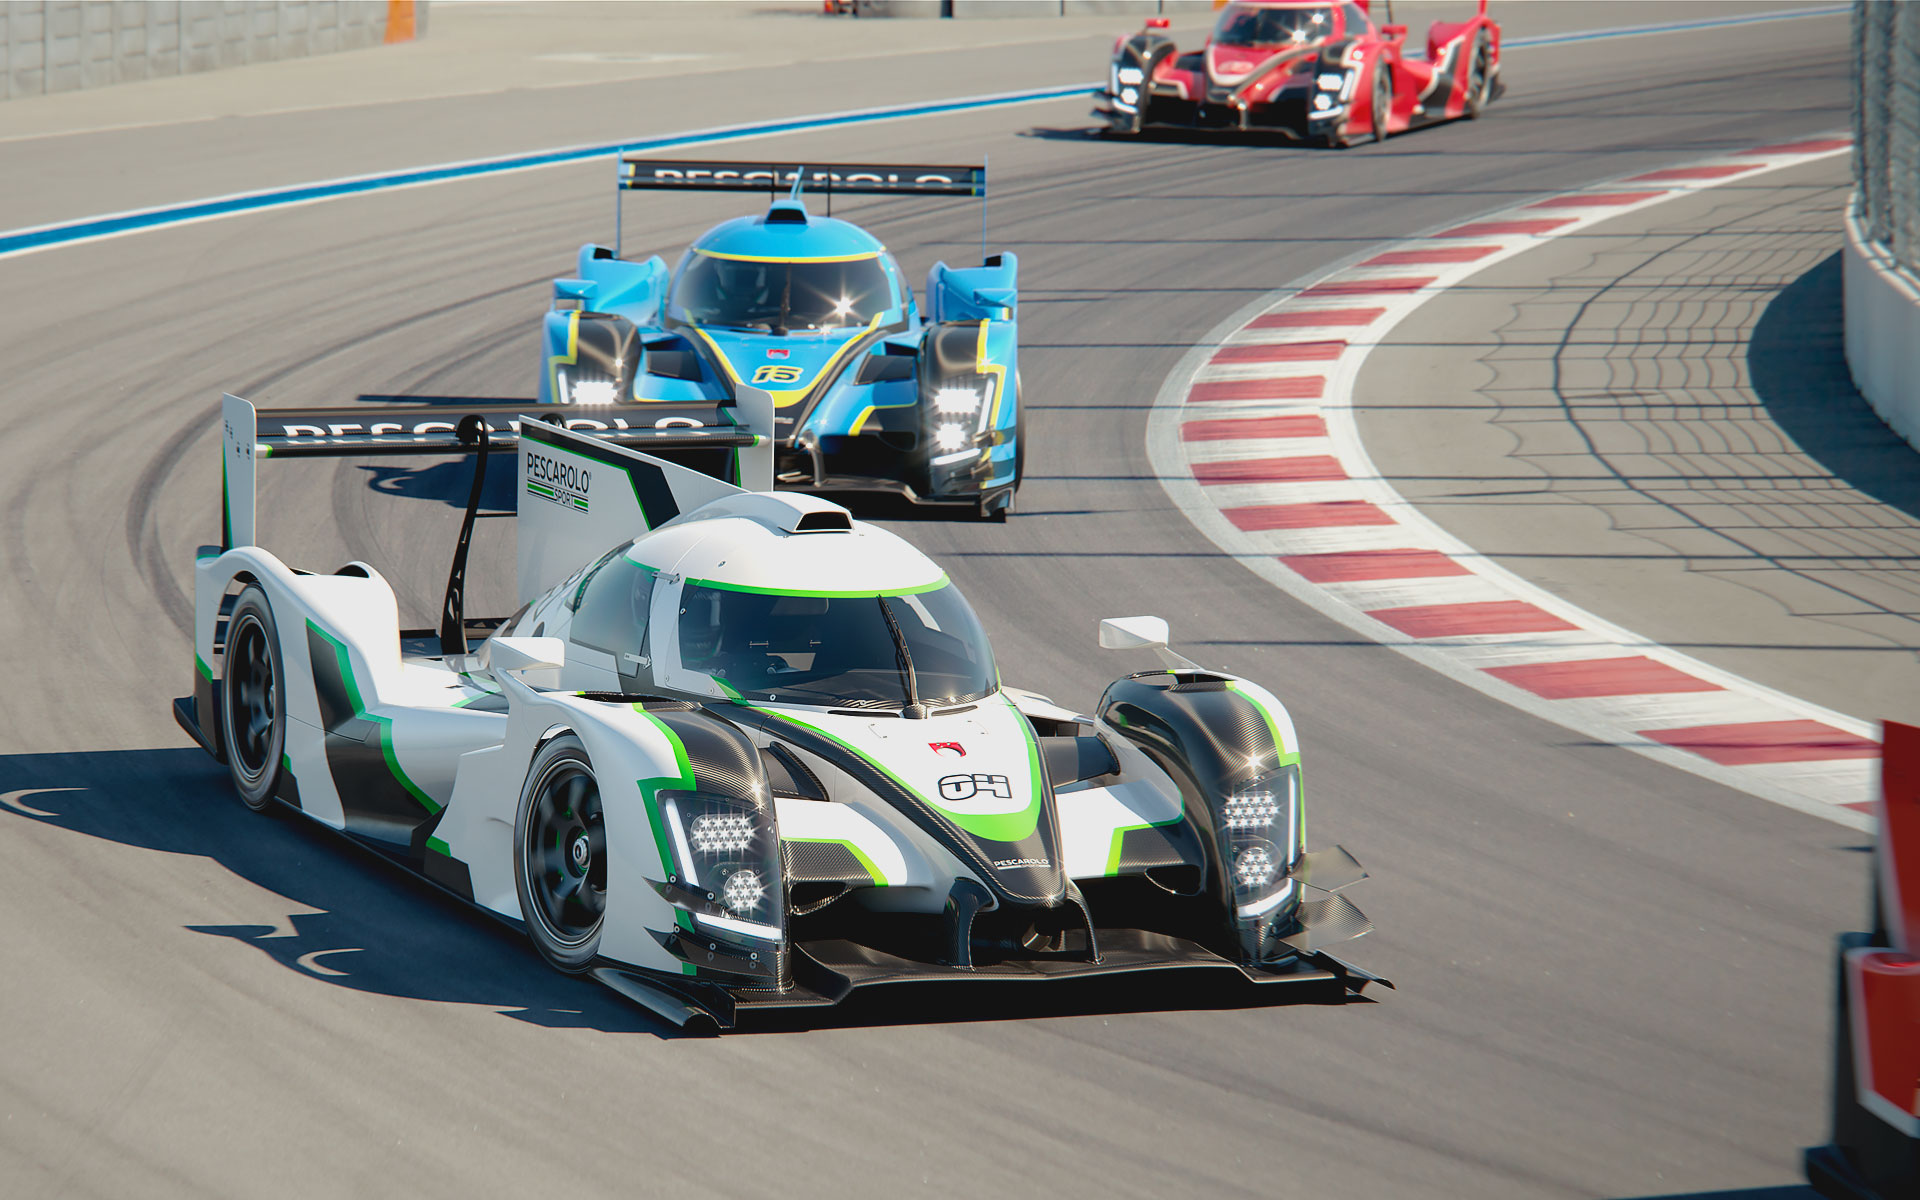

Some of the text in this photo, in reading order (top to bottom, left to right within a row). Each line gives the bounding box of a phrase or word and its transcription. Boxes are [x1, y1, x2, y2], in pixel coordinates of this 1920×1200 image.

[751, 365, 804, 383] 15
[527, 452, 589, 493] PESCAROLO
[554, 488, 574, 507] SPORT
[938, 774, 1012, 801] 04
[993, 858, 1049, 867] PESCAROLO
